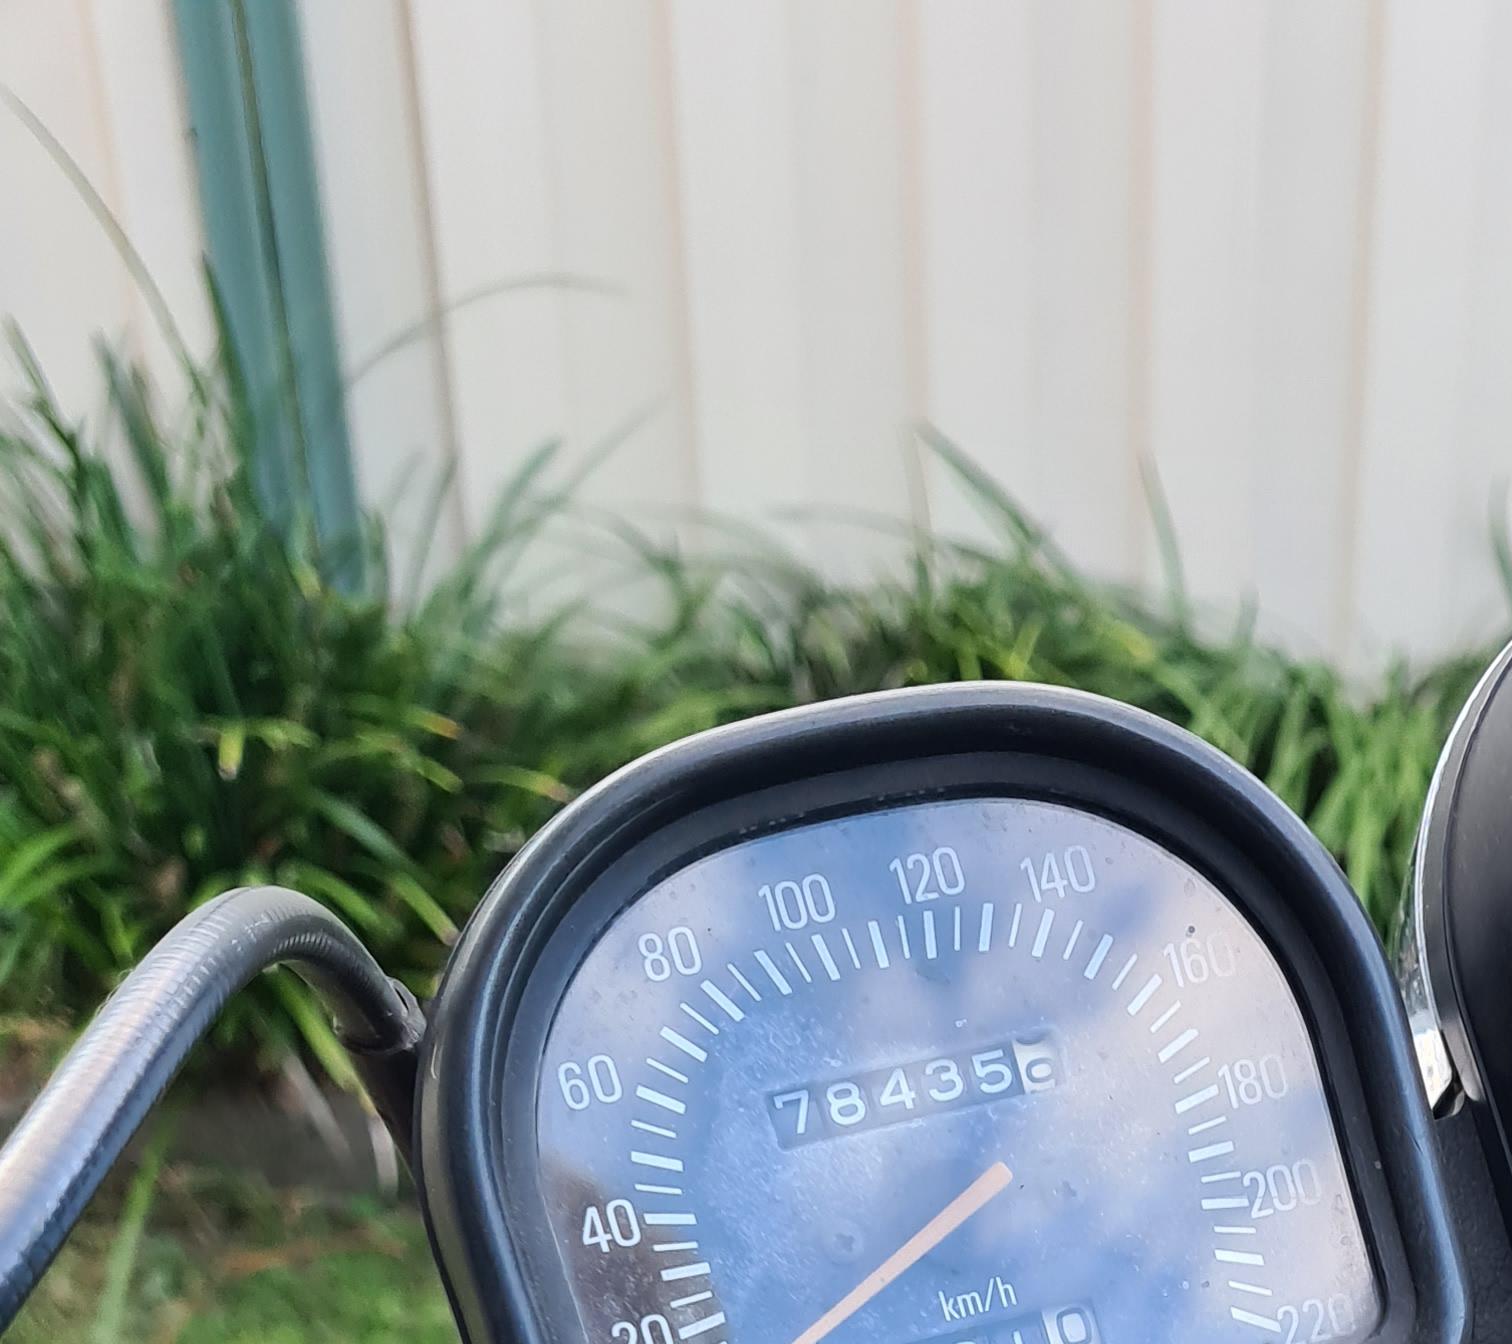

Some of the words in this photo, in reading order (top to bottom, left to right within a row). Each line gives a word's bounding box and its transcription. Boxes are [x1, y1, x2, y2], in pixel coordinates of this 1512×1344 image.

[888, 846, 967, 905] 120
[1019, 844, 1097, 902] 140
[757, 873, 837, 932] 100
[637, 925, 702, 983] 80
[1163, 930, 1236, 988] 160
[557, 1053, 623, 1110] 60
[1216, 1053, 1288, 1110] 180
[1242, 1157, 1322, 1219] 200
[581, 1198, 642, 1254] 40
[938, 1276, 1018, 1322] km/h
